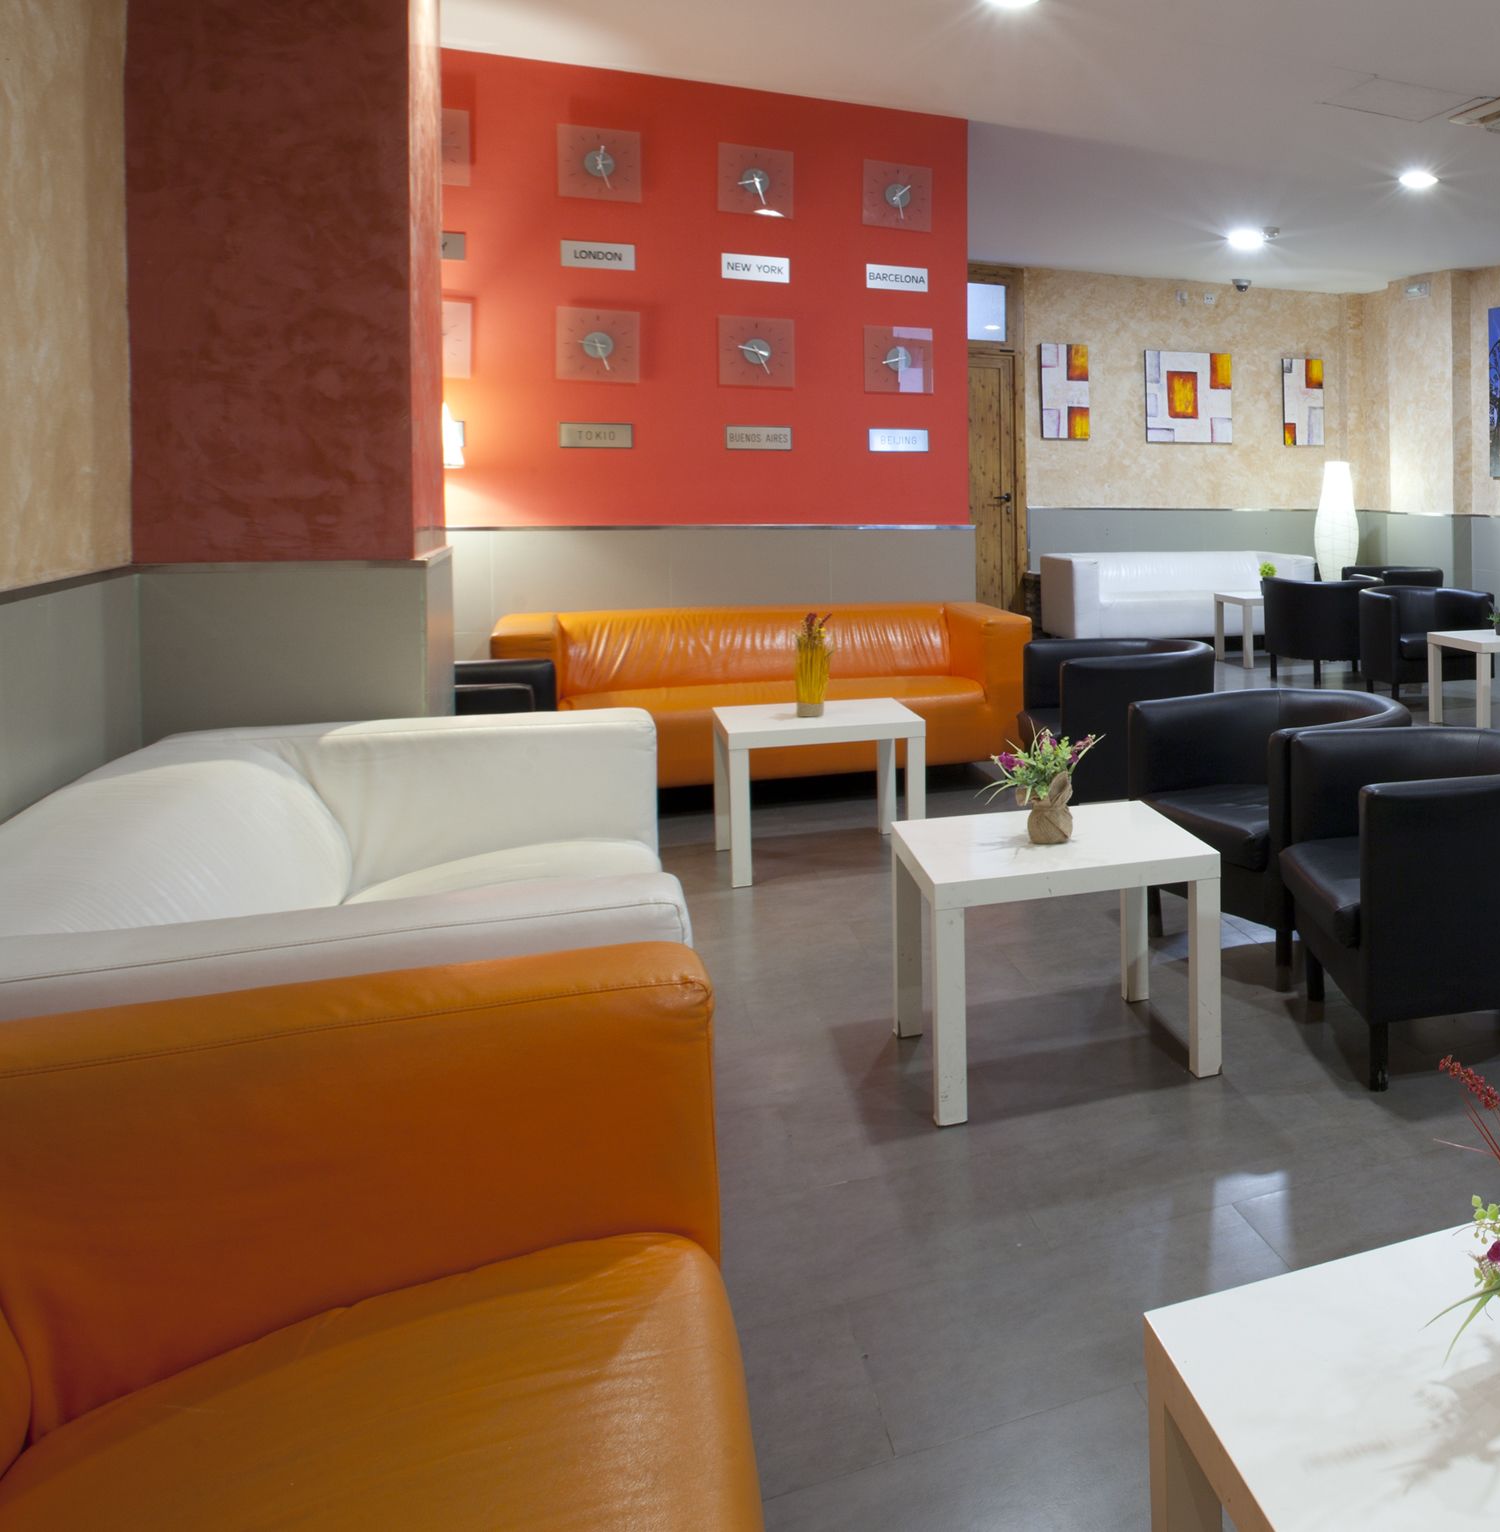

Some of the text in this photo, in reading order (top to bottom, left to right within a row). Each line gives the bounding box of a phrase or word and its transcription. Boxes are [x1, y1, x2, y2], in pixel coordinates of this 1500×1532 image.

[573, 249, 623, 261] LONDON
[726, 261, 784, 275] NEW YORK
[868, 271, 926, 284] BARCELONA
[576, 430, 616, 441] TOKIO
[728, 431, 789, 444] BUENOS AIRES
[880, 435, 918, 446] BEIJING
